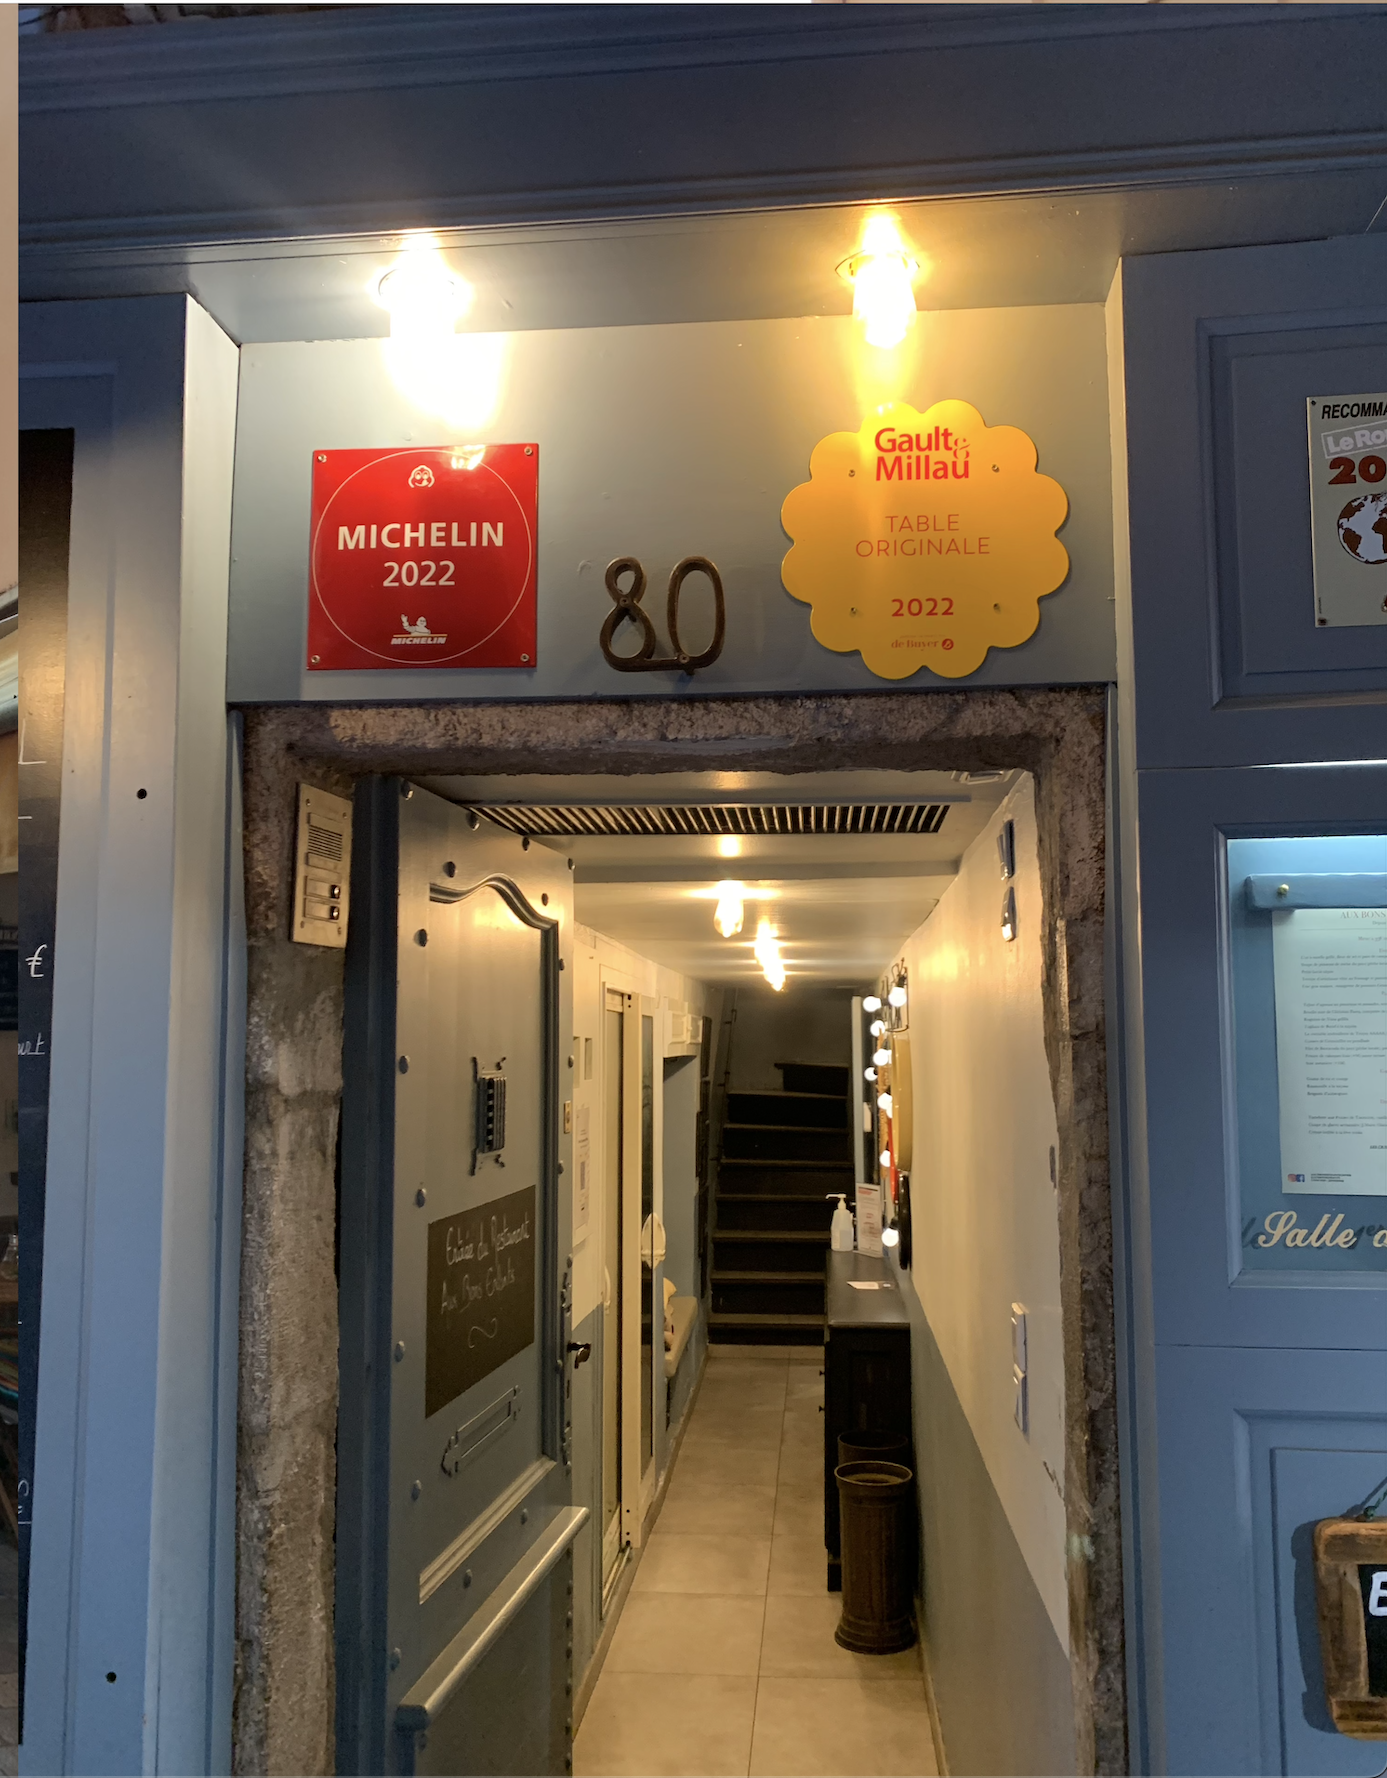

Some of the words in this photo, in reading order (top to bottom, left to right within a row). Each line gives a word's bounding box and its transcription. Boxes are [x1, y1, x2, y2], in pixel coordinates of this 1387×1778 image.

[874, 425, 953, 453] Gault
[875, 454, 970, 482] Millau
[337, 522, 504, 550] MICHELIN
[885, 514, 960, 533] TABLE
[855, 536, 991, 558] ORIGINALE
[382, 560, 456, 587] 2022
[599, 555, 726, 673] 80
[891, 597, 954, 617] 2022
[390, 636, 447, 645] MICHELIN
[891, 639, 905, 649] de
[1340, 910, 1360, 919] AUX
[1361, 910, 1387, 919] BONS
[25, 944, 48, 979] €
[1257, 1210, 1357, 1248] Salle
